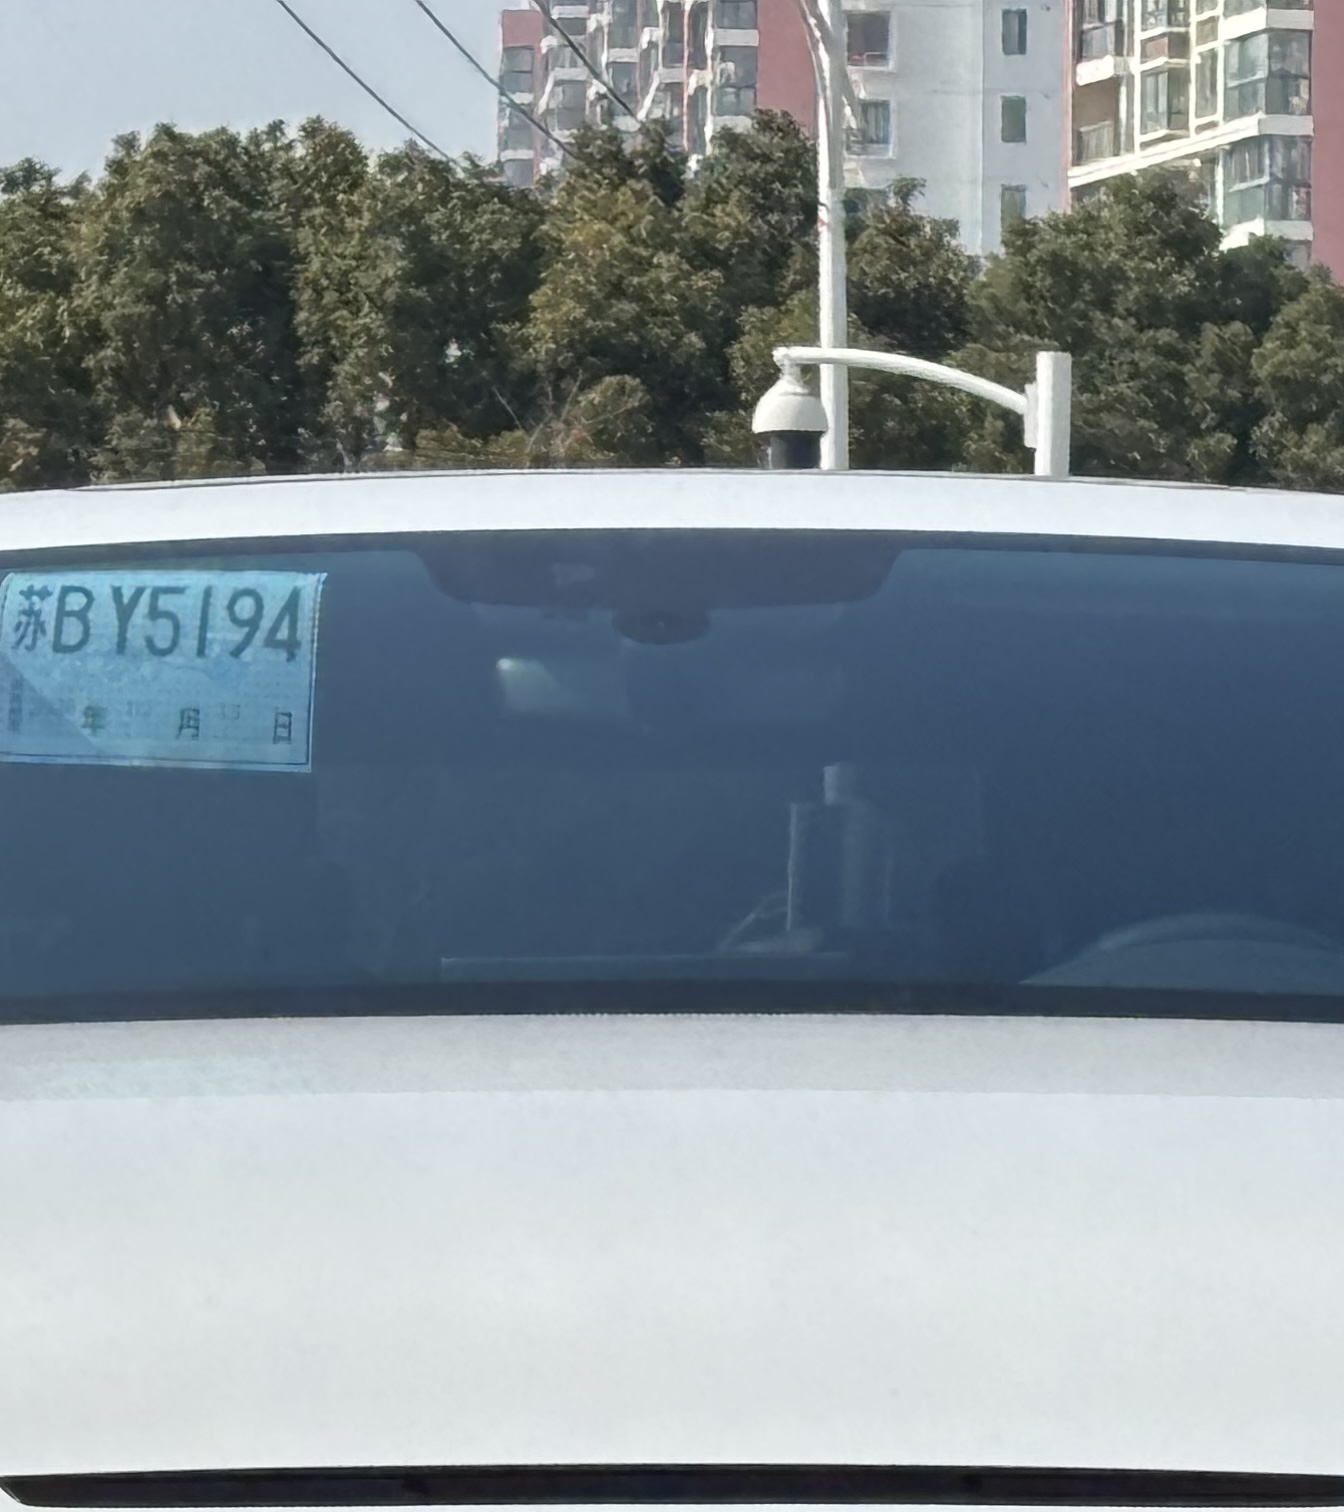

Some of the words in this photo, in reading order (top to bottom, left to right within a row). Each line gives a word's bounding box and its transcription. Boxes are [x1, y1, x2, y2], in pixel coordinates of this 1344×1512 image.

[11, 584, 304, 662] 苏BY5194
[175, 706, 201, 741] 月
[272, 710, 293, 744] 日
